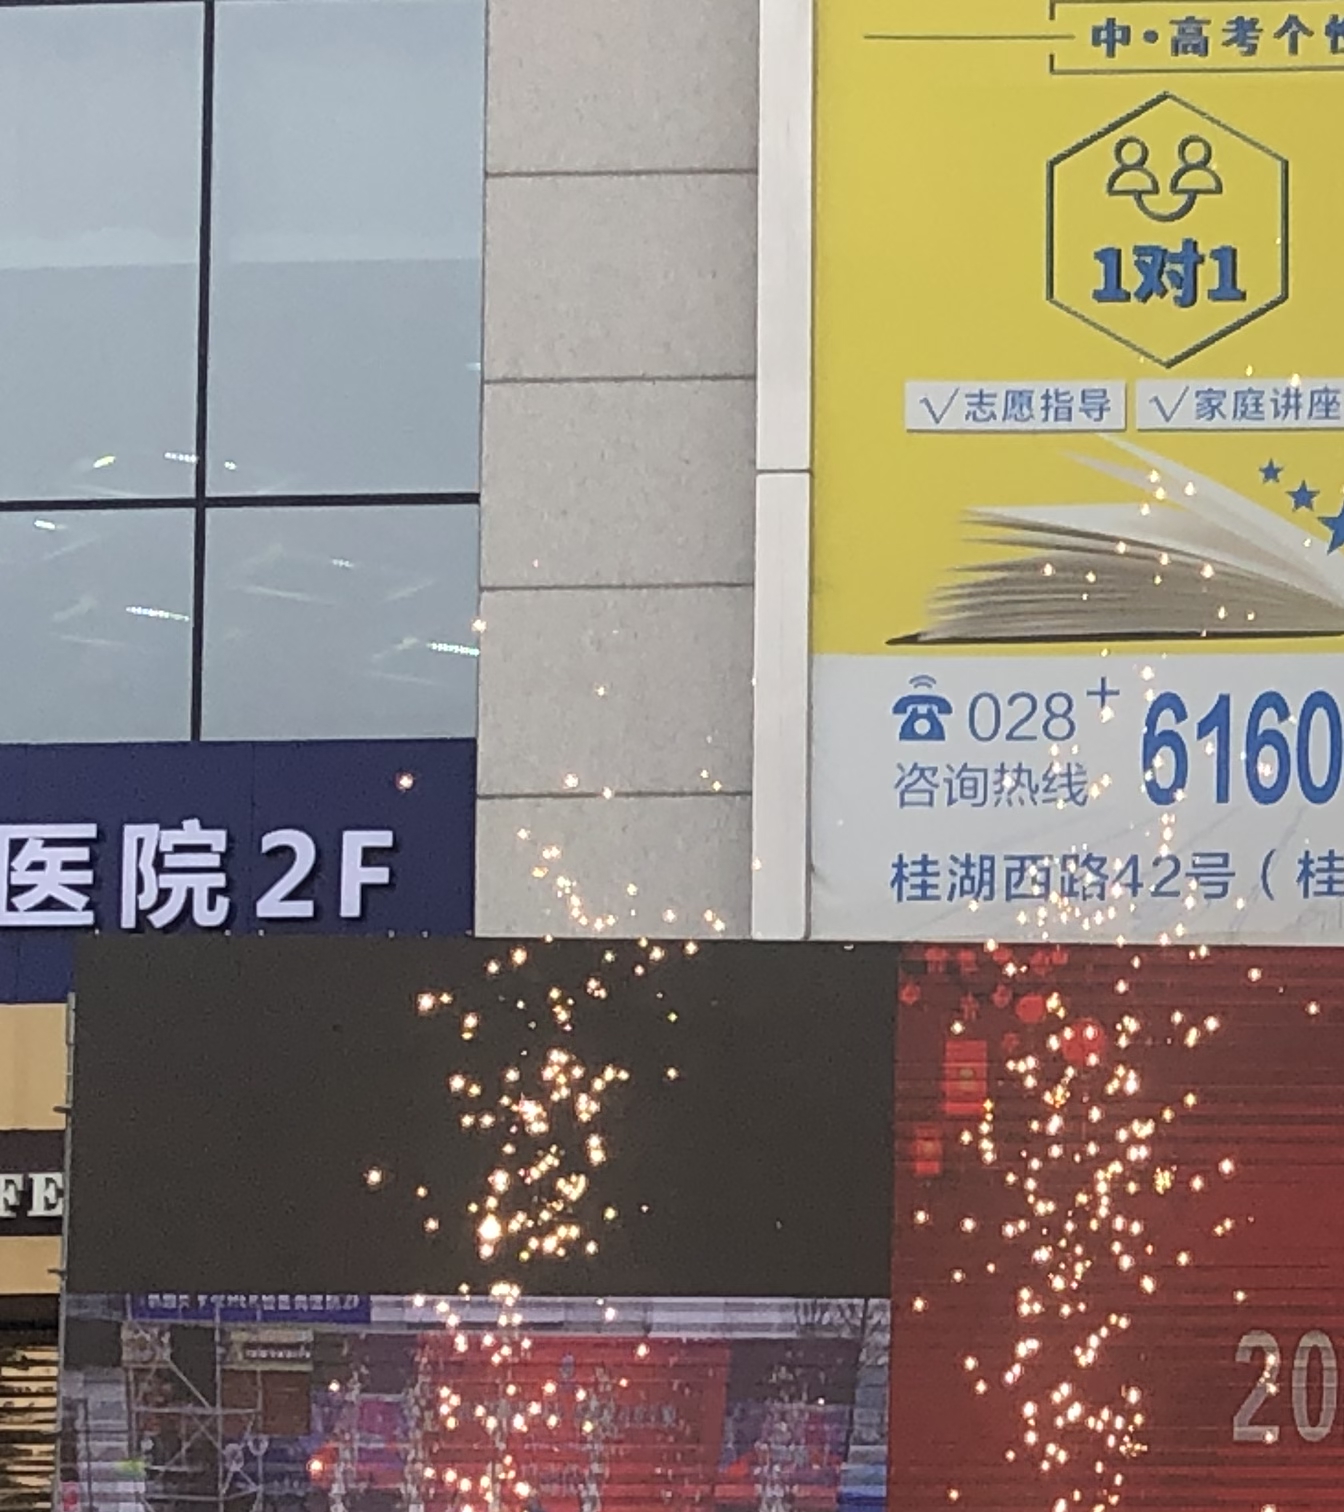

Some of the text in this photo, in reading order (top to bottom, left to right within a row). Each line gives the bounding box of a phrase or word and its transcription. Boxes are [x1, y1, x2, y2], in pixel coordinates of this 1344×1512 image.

[1092, 237, 1247, 308] 1对1
[964, 387, 1112, 423] 志愿指导
[1194, 386, 1341, 422] 家庭讲座
[893, 761, 1090, 809] 咨询热线
